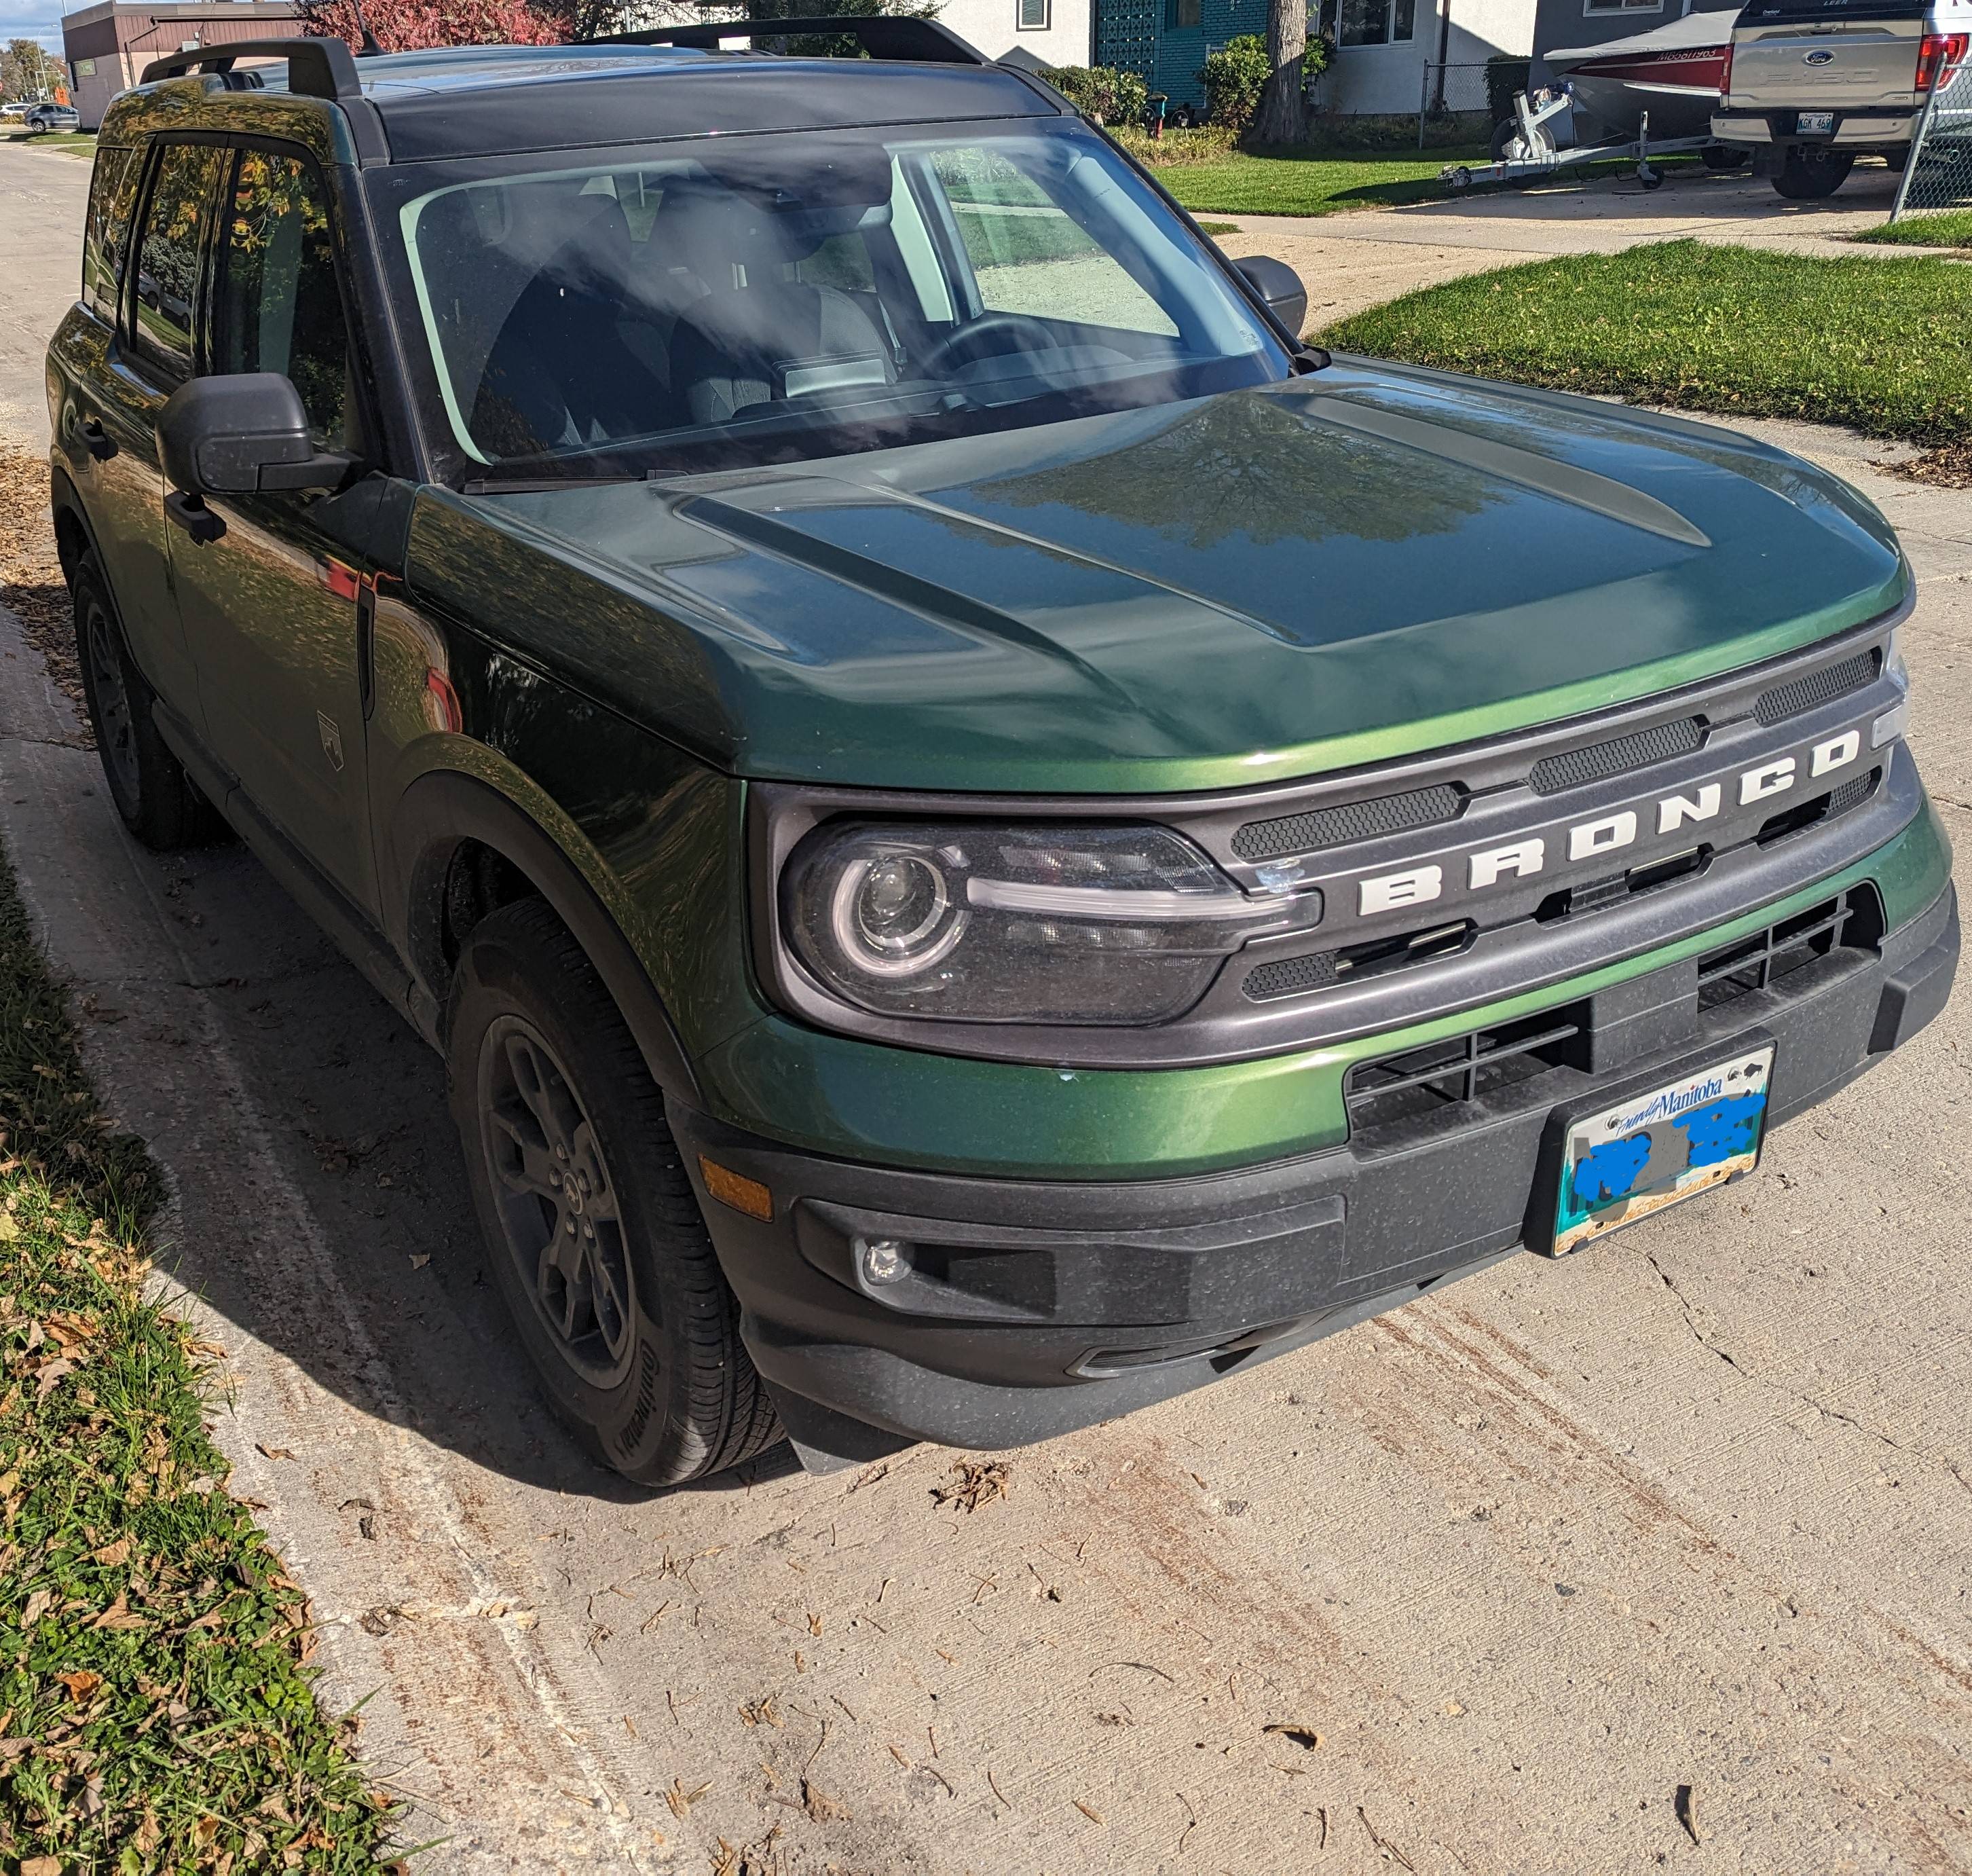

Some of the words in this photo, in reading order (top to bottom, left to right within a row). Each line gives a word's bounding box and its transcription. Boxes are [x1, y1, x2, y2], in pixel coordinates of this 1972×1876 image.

[1817, 118, 1831, 129] 469
[1358, 730, 1860, 917] BRONCO
[1658, 1078, 1722, 1119] Manitoba
